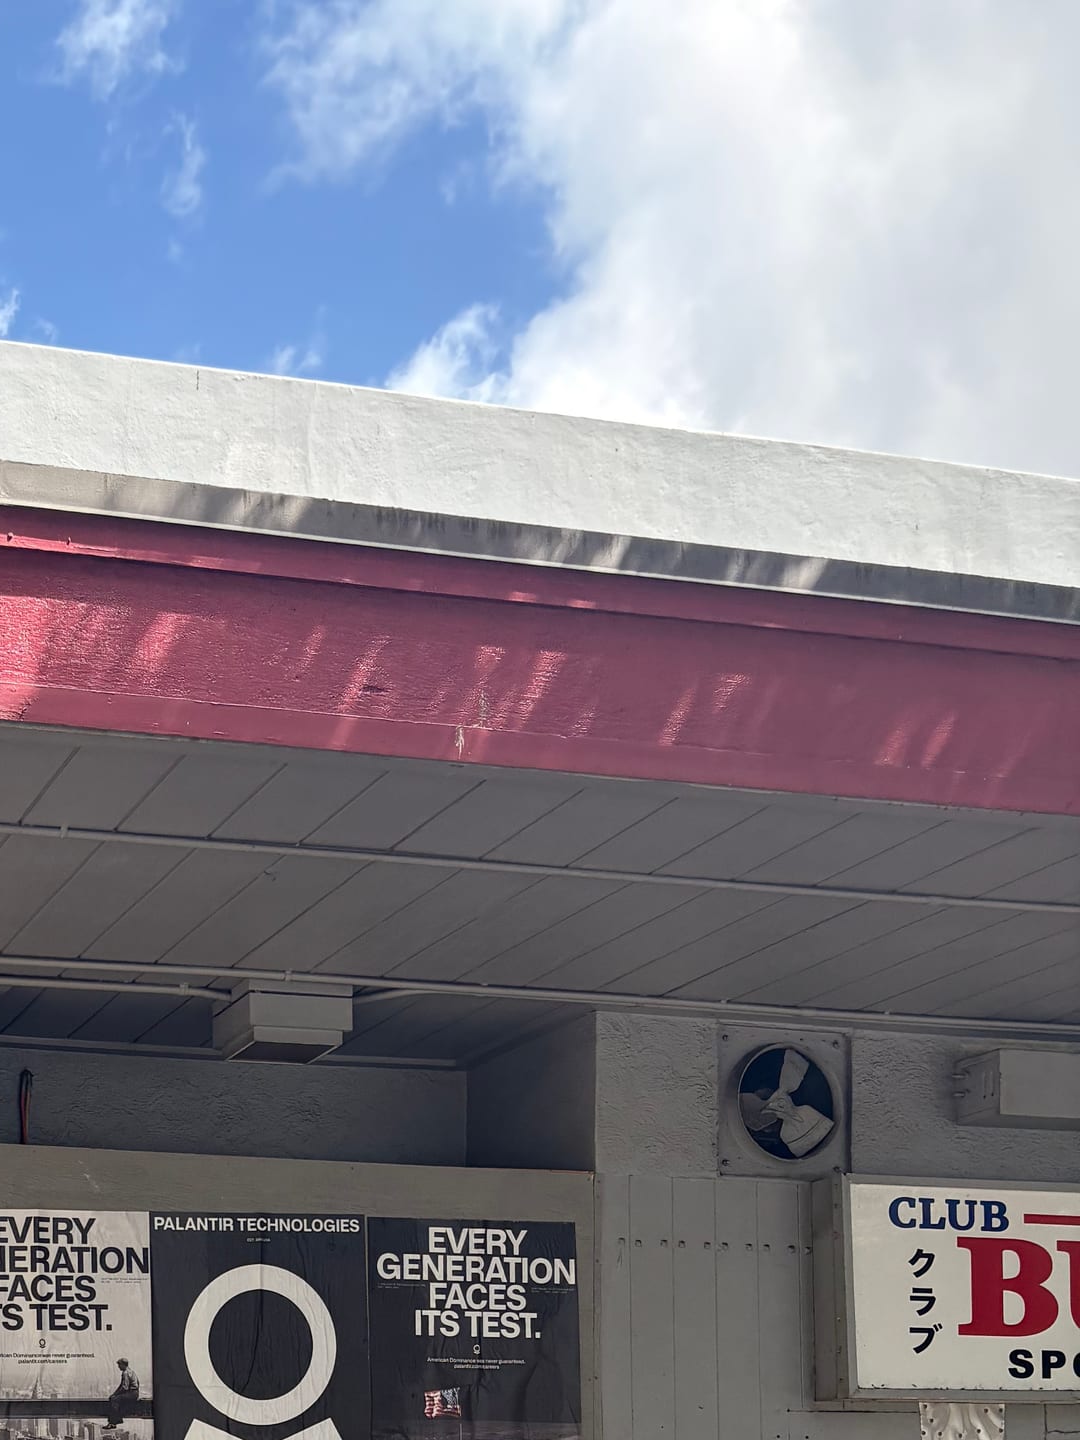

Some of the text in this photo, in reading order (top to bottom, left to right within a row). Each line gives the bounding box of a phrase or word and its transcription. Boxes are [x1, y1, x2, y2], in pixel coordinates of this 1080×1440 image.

[154, 1217, 360, 1232] PALANTIR TECHNOLOGIES
[889, 1197, 1009, 1232] CLUB
[429, 1227, 527, 1255] EVERY
[377, 1253, 575, 1285] GENERATION
[429, 1283, 526, 1310] FACES
[956, 1236, 1080, 1337] B
[909, 1248, 943, 1354] クラブ
[29, 1304, 112, 1331] TEST.
[415, 1310, 540, 1338] ITS TEST.
